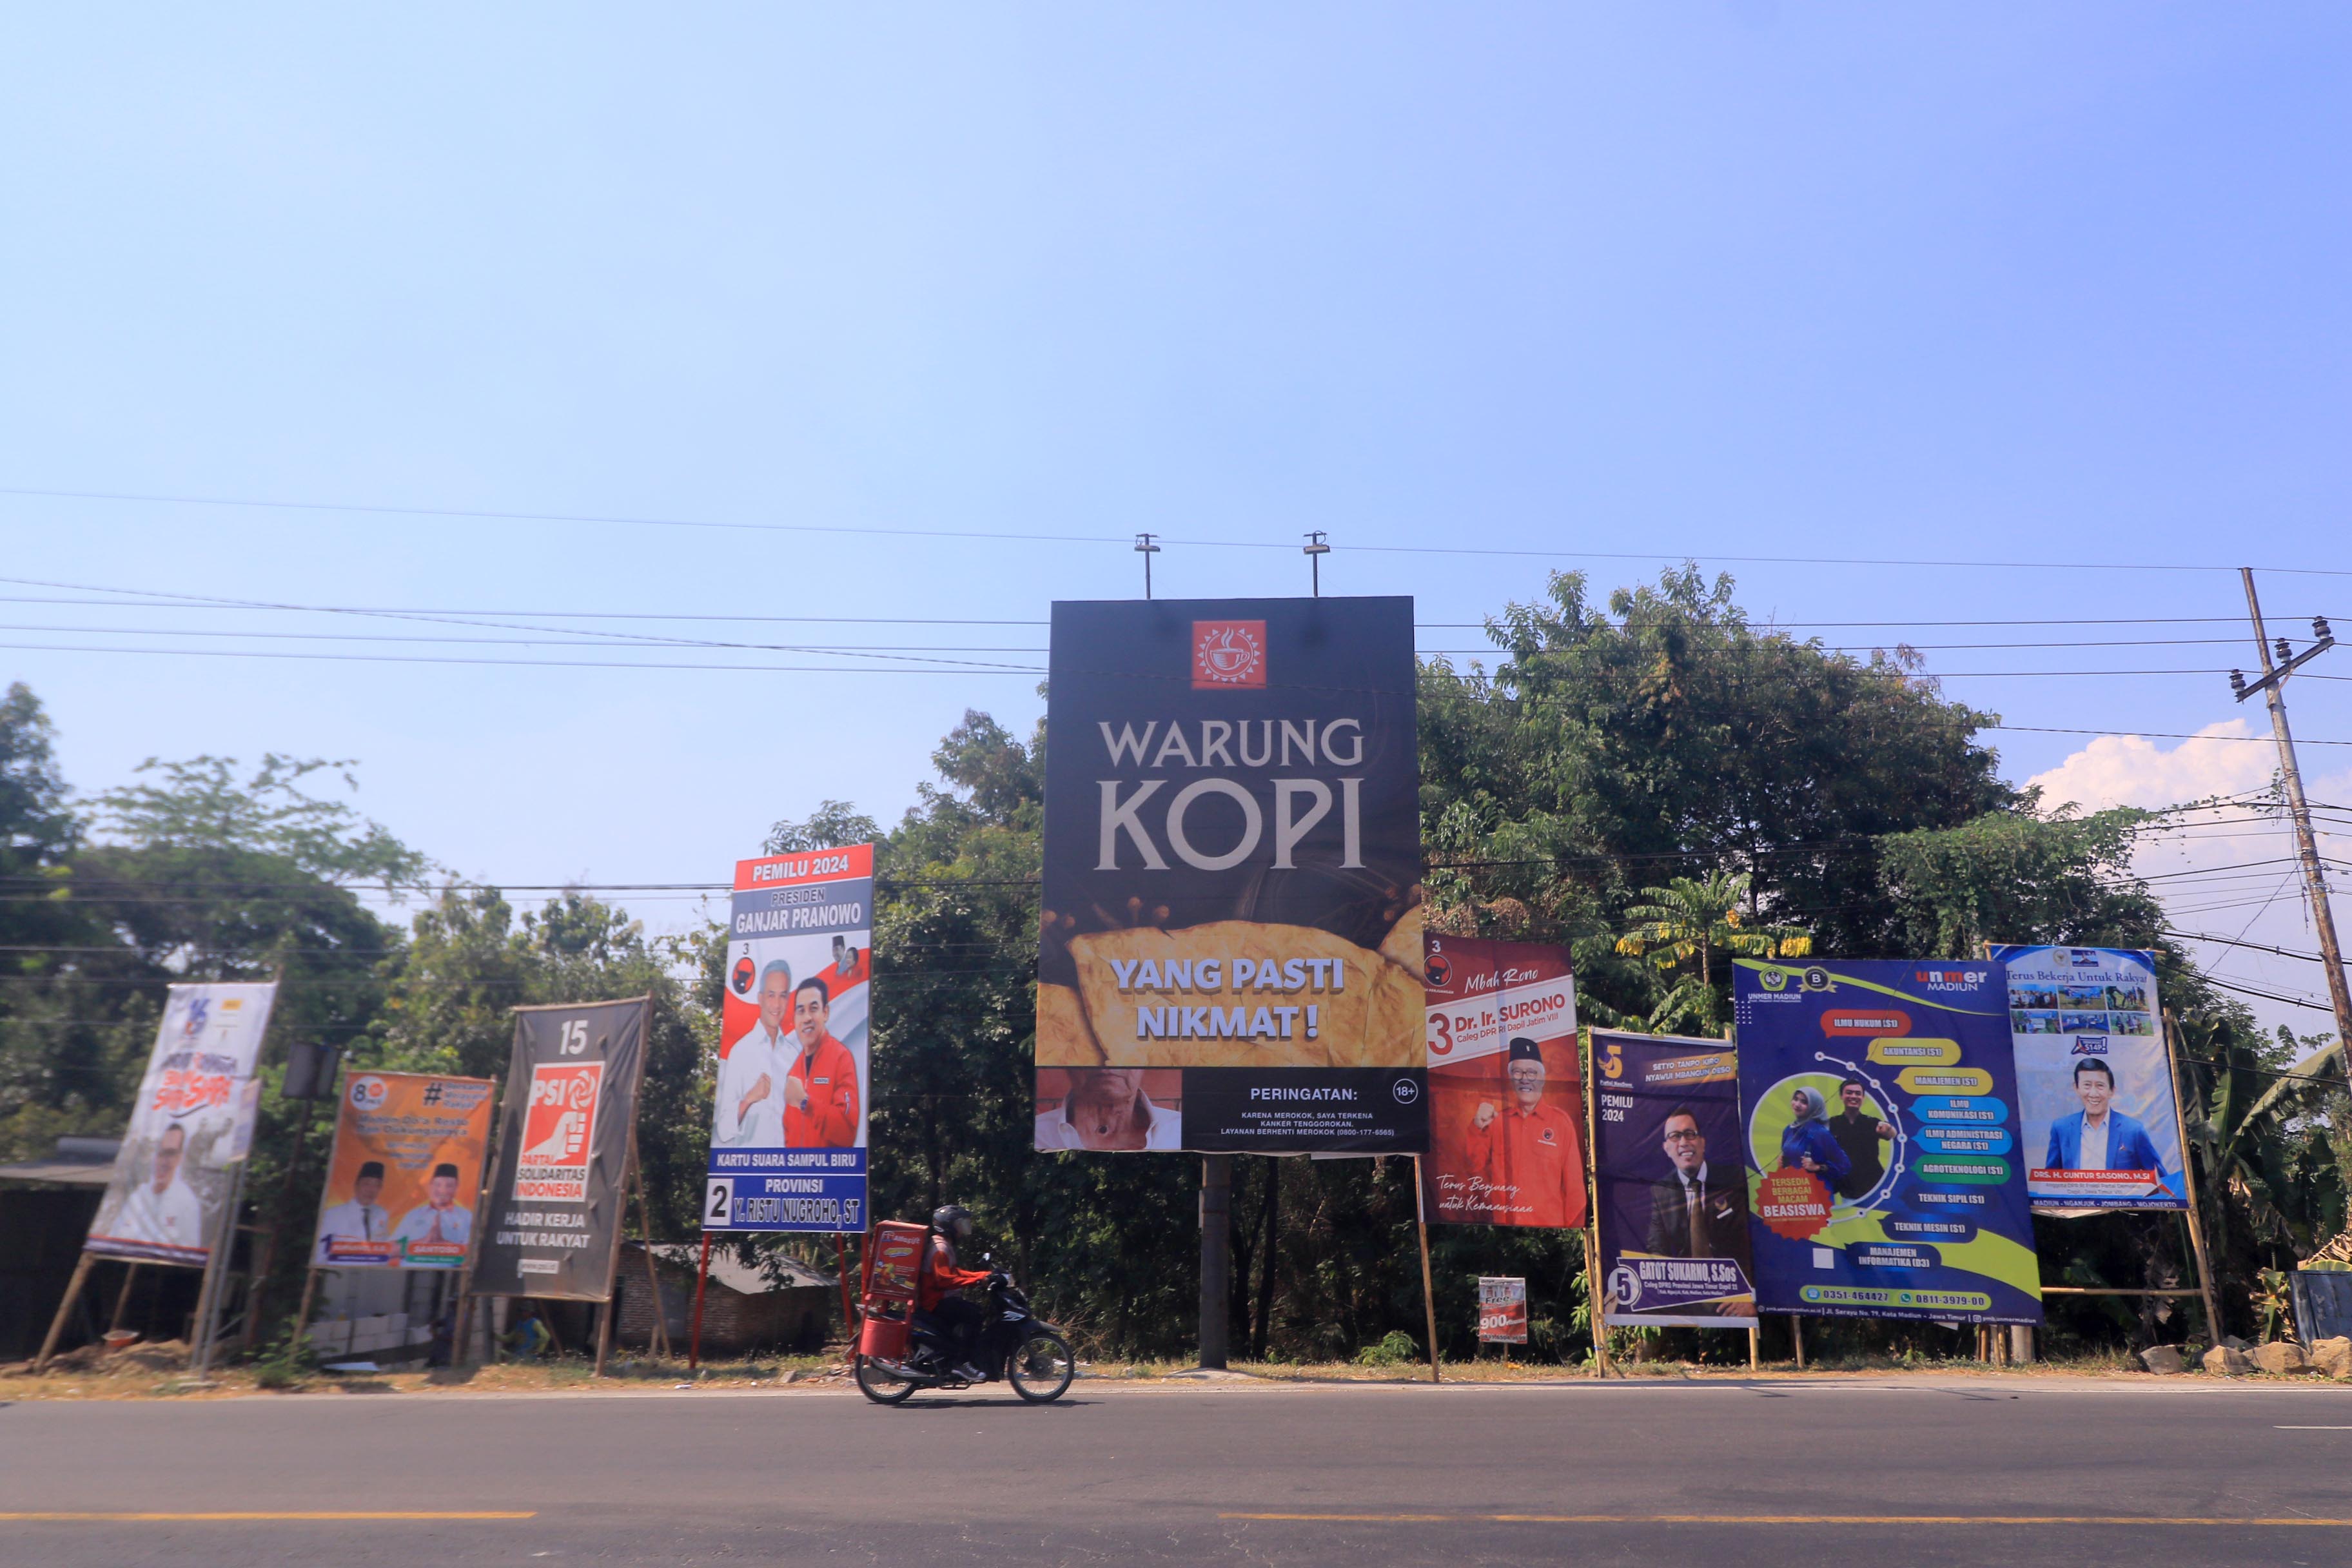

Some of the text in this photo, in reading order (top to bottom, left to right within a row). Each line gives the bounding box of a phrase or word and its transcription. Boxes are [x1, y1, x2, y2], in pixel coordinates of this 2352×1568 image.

[1099, 718, 1364, 768] WARUNG
[1093, 778, 1366, 871] KOPI
[752, 854, 848, 882] PEMILU 2024
[771, 887, 825, 906] PRESIDEN
[736, 903, 861, 934] GANJAR PRANOWO
[742, 943, 749, 955] 3
[1431, 940, 1441, 953] 3
[1110, 958, 1344, 994] YANG PASTI
[1464, 968, 1538, 994] Mbah Rono
[1812, 974, 1821, 983] B
[1916, 971, 1987, 983] unmer
[2006, 970, 2035, 981] Terus
[2037, 970, 2075, 983] Bekerja
[2076, 972, 2113, 982] Untuk
[1927, 982, 1978, 991] MADIUN
[1455, 994, 1565, 1032] Dr. Ir. SURONO
[1456, 1032, 1478, 1044] Caleg
[1480, 1027, 1496, 1037] DPR
[1498, 1024, 1506, 1034] RI
[1507, 1021, 1525, 1032] Dapil
[1526, 1016, 1545, 1028] Jatim
[1834, 1019, 1852, 1027] ILMU
[1854, 1019, 1881, 1028] HUKUM
[560, 1019, 589, 1055] 15
[1427, 1013, 1453, 1055] 3
[1883, 1047, 1926, 1056] AKUNTANSI
[1914, 1076, 1961, 1085] MANAJEMEN
[353, 1084, 366, 1102] 8
[532, 1077, 566, 1106] PSI
[1251, 1088, 1357, 1101] PERINGATAN:
[1395, 1087, 1415, 1096] 18+
[1601, 1094, 1633, 1108] PEMILU
[1950, 1099, 1970, 1108] ILMU
[1602, 1109, 1624, 1122] 2024
[1928, 1110, 1977, 1119] KOMUNIKASI
[1337, 1128, 1394, 1137] (0800-177-6565)
[1925, 1129, 2003, 1139] ILMU ADMINISTRASI
[1941, 1141, 1972, 1150] NEGARA
[717, 1154, 856, 1166] KARTU SUARA SAMPUL BIRU
[518, 1168, 585, 1181] SOLIDARITAS
[1923, 1164, 1986, 1174] AGROTEKNOLOGI
[765, 1179, 823, 1193] PROVINSI
[1436, 1173, 1520, 1199] Terus Berjuang
[1771, 1177, 1810, 1186] TERSEDIA
[516, 1182, 582, 1197] INDONESIA
[1772, 1186, 1812, 1195] BERBAGAI
[710, 1185, 727, 1217] 2
[1439, 1194, 1533, 1213] untuk Kemanusiaan
[1778, 1195, 1808, 1204] MACAM
[1918, 1193, 1947, 1202] TEKNIK
[1948, 1194, 1968, 1203] SIPIL
[733, 1197, 860, 1229] Y. RISTU NUGROHO, ST
[1763, 1204, 1826, 1217] BEASISWA
[504, 1212, 585, 1228] HADIR KERJA
[1894, 1222, 1923, 1231] TEKNIK
[1923, 1222, 1948, 1233] MESIN
[496, 1231, 591, 1248] UNTUK RAKYAT
[1870, 1247, 1917, 1257] MANAJEMEN
[1858, 1256, 1912, 1266] INFORMATIKA
[1640, 1261, 1666, 1280] GATOT
[1667, 1262, 1710, 1282] SUKARNO,
[1616, 1273, 1631, 1301] 5
[1485, 1296, 1509, 1304] Free
[1823, 1289, 1888, 1301] 0351-464427
[1916, 1294, 1984, 1306] 0811-3979-00
[1480, 1314, 1507, 1329] 900
